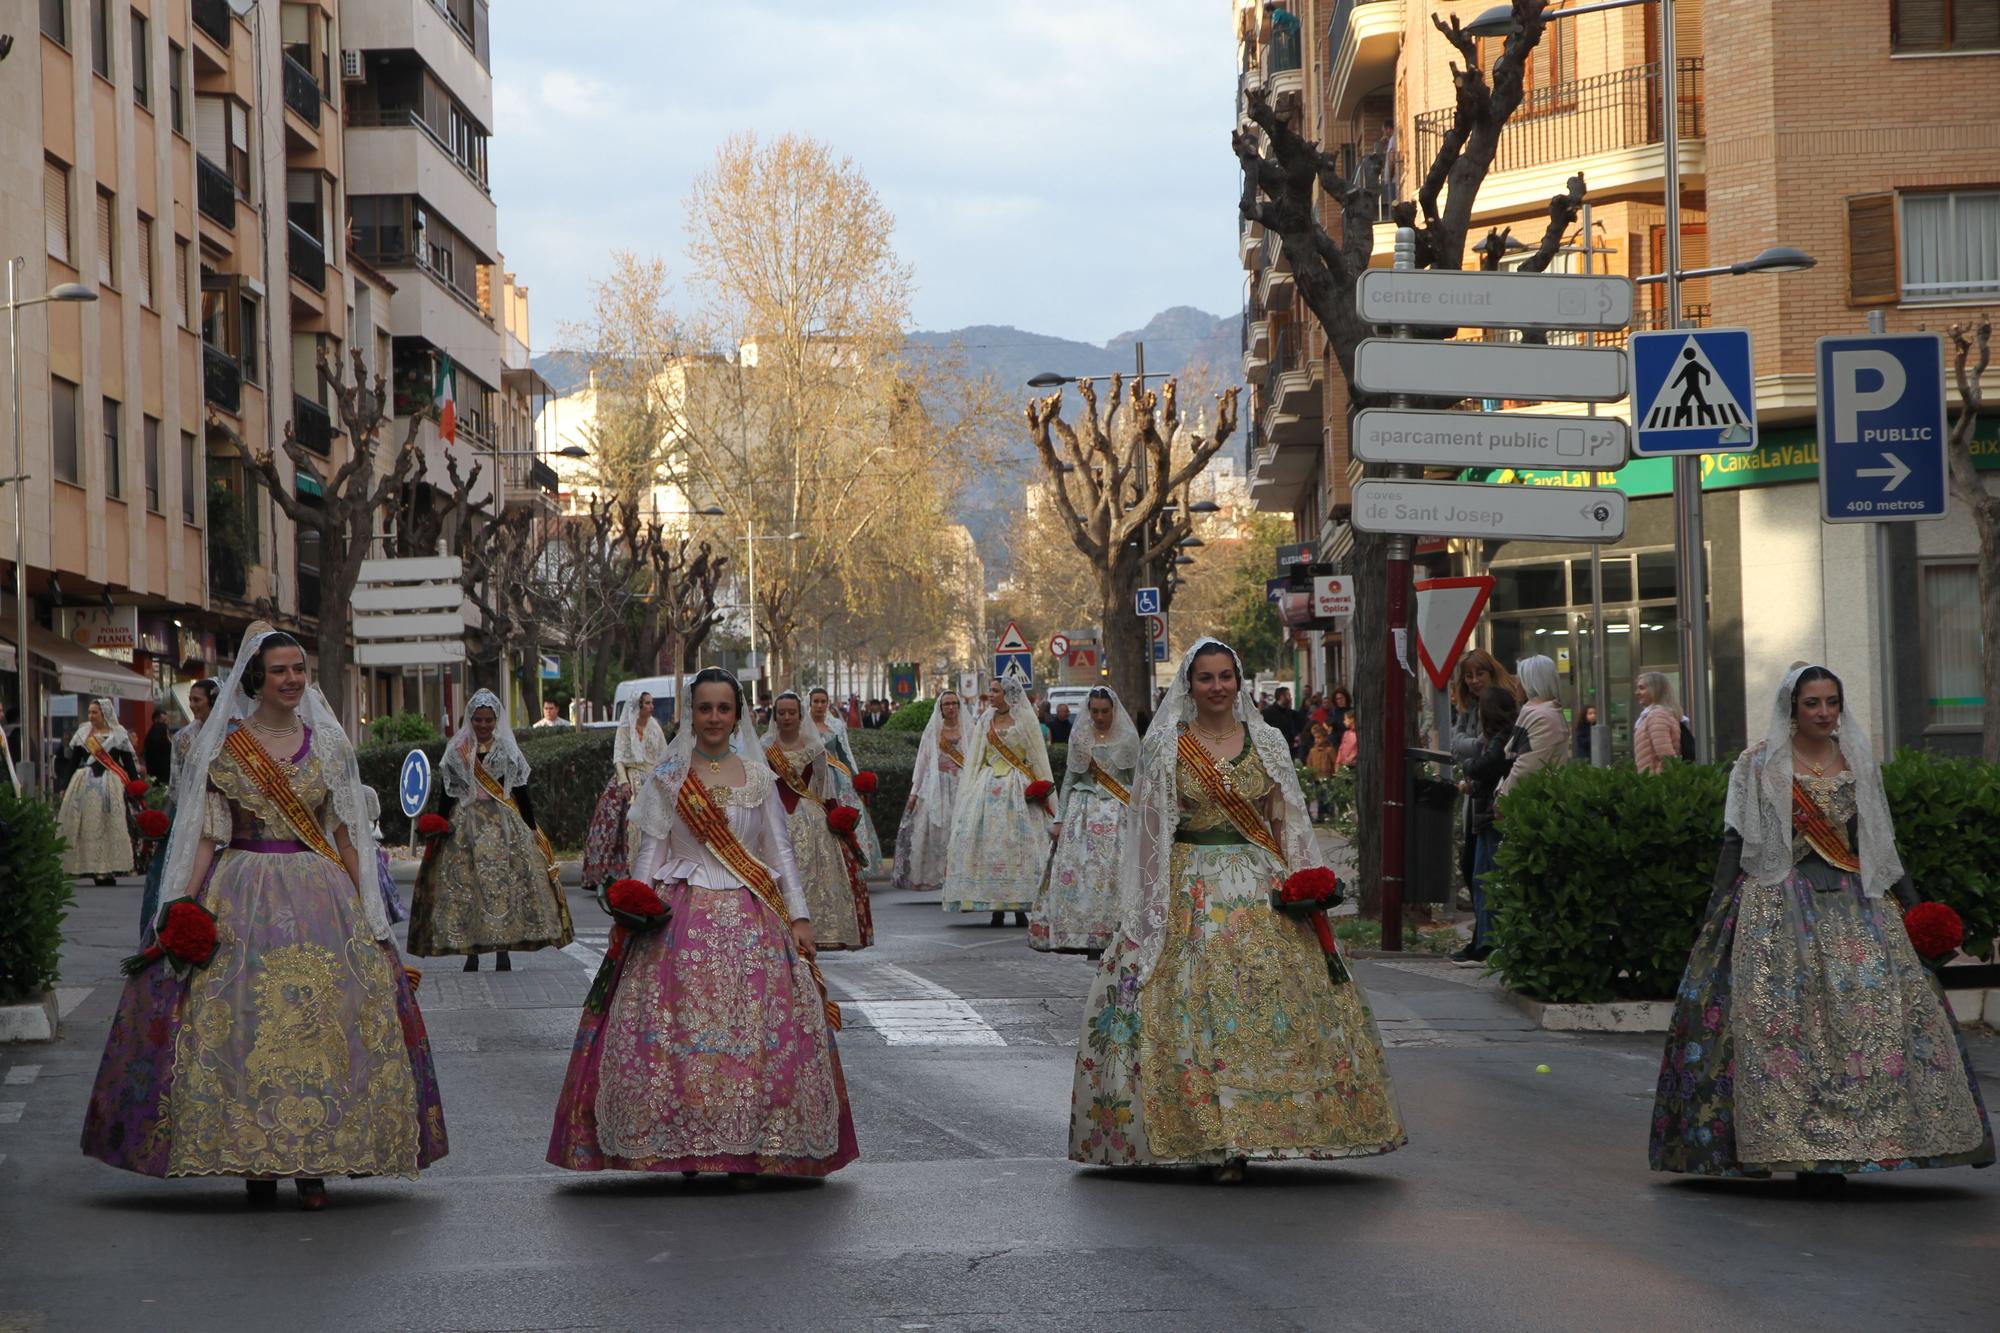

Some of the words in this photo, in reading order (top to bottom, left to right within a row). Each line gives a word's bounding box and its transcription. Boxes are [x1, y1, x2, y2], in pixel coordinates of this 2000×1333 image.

[1371, 288, 1433, 304] centre
[1438, 289, 1492, 306] ciutat
[1832, 350, 1907, 444] P
[1369, 429, 1483, 447] aparcament
[1488, 432, 1550, 450] public
[1864, 427, 1932, 443] PUBLIC
[1366, 491, 1403, 501] coves
[1846, 501, 1873, 512] 400
[1877, 500, 1925, 511] metros
[1365, 503, 1388, 519] de
[1394, 504, 1439, 521] Sant
[1444, 505, 1504, 527] Josep
[1319, 595, 1352, 604] General
[1322, 605, 1349, 614] Optica
[97, 634, 134, 643] PLANES
